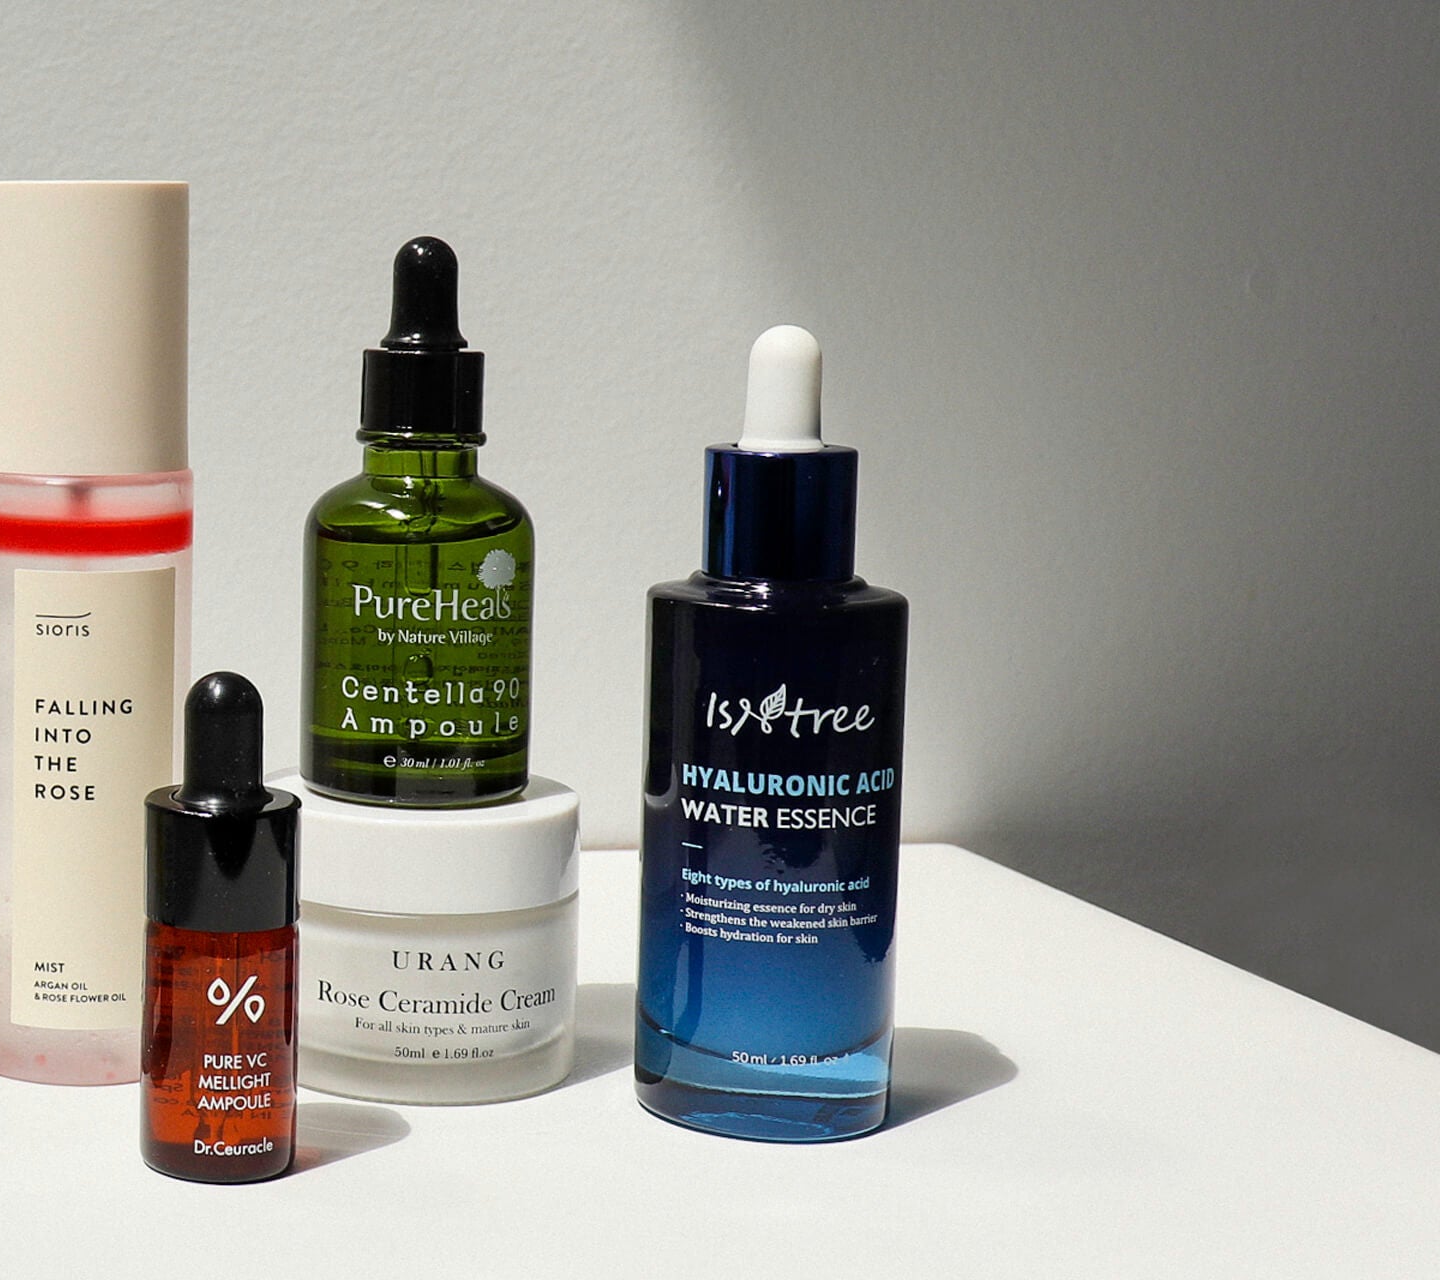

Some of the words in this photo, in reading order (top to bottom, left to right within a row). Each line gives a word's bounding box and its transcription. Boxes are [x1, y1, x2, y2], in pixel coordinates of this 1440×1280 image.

[352, 584, 512, 622] PureHeals
[378, 628, 395, 646] by
[398, 629, 446, 644] Nature
[449, 630, 493, 646] Village
[341, 675, 484, 704] Centella
[493, 677, 520, 701] 90
[35, 699, 133, 715] FALLING
[341, 707, 520, 740] Ampoule
[35, 728, 91, 744] INTO
[34, 755, 77, 772] THE
[440, 758, 461, 768] 1.01
[682, 763, 850, 797] HYALURONIC
[856, 767, 894, 795] ACID
[35, 784, 95, 800] ROSE
[681, 798, 769, 829] WATER
[776, 804, 877, 829] ESSENCE
[681, 868, 711, 885] Eight
[714, 875, 752, 891] types
[755, 879, 771, 891] of
[773, 880, 845, 896] hyaluronic
[848, 876, 870, 891] acid
[685, 892, 751, 914] Moisturizing
[753, 903, 797, 914] essence
[799, 902, 816, 914] for
[817, 902, 834, 916] dry
[836, 901, 857, 913] skin
[685, 908, 746, 926] Strengthens
[749, 916, 768, 928] the
[770, 917, 826, 929] weakened
[827, 917, 848, 928] skin
[850, 913, 878, 926] barrier
[685, 922, 718, 937] Boosts
[720, 925, 774, 943] hydration
[776, 933, 794, 943] for
[795, 933, 818, 944] skin
[34, 962, 65, 973] MIST
[392, 950, 505, 971] URANG
[34, 981, 68, 990] ARGAN
[71, 982, 88, 991] OIL
[42, 993, 67, 1002] ROSE
[70, 993, 109, 1003] FLOWER
[111, 993, 126, 1002] OIL
[318, 980, 370, 1009] Rose
[379, 989, 493, 1014] Ceramide
[501, 987, 556, 1012] Cream
[355, 1017, 375, 1030] For
[378, 1020, 392, 1033] all
[396, 1022, 420, 1034] skin
[424, 1025, 454, 1037] types
[457, 1023, 467, 1035] &
[471, 1023, 509, 1034] mature
[511, 1019, 530, 1032] skin
[204, 1053, 242, 1070] PURE
[246, 1053, 268, 1068] VC
[393, 1047, 425, 1059] 50ml
[443, 1048, 468, 1059] 1.69
[198, 1072, 271, 1090] MELLIGHT
[197, 1093, 271, 1111] AMPOULE
[194, 1137, 273, 1156] Dr.Ceuracle
